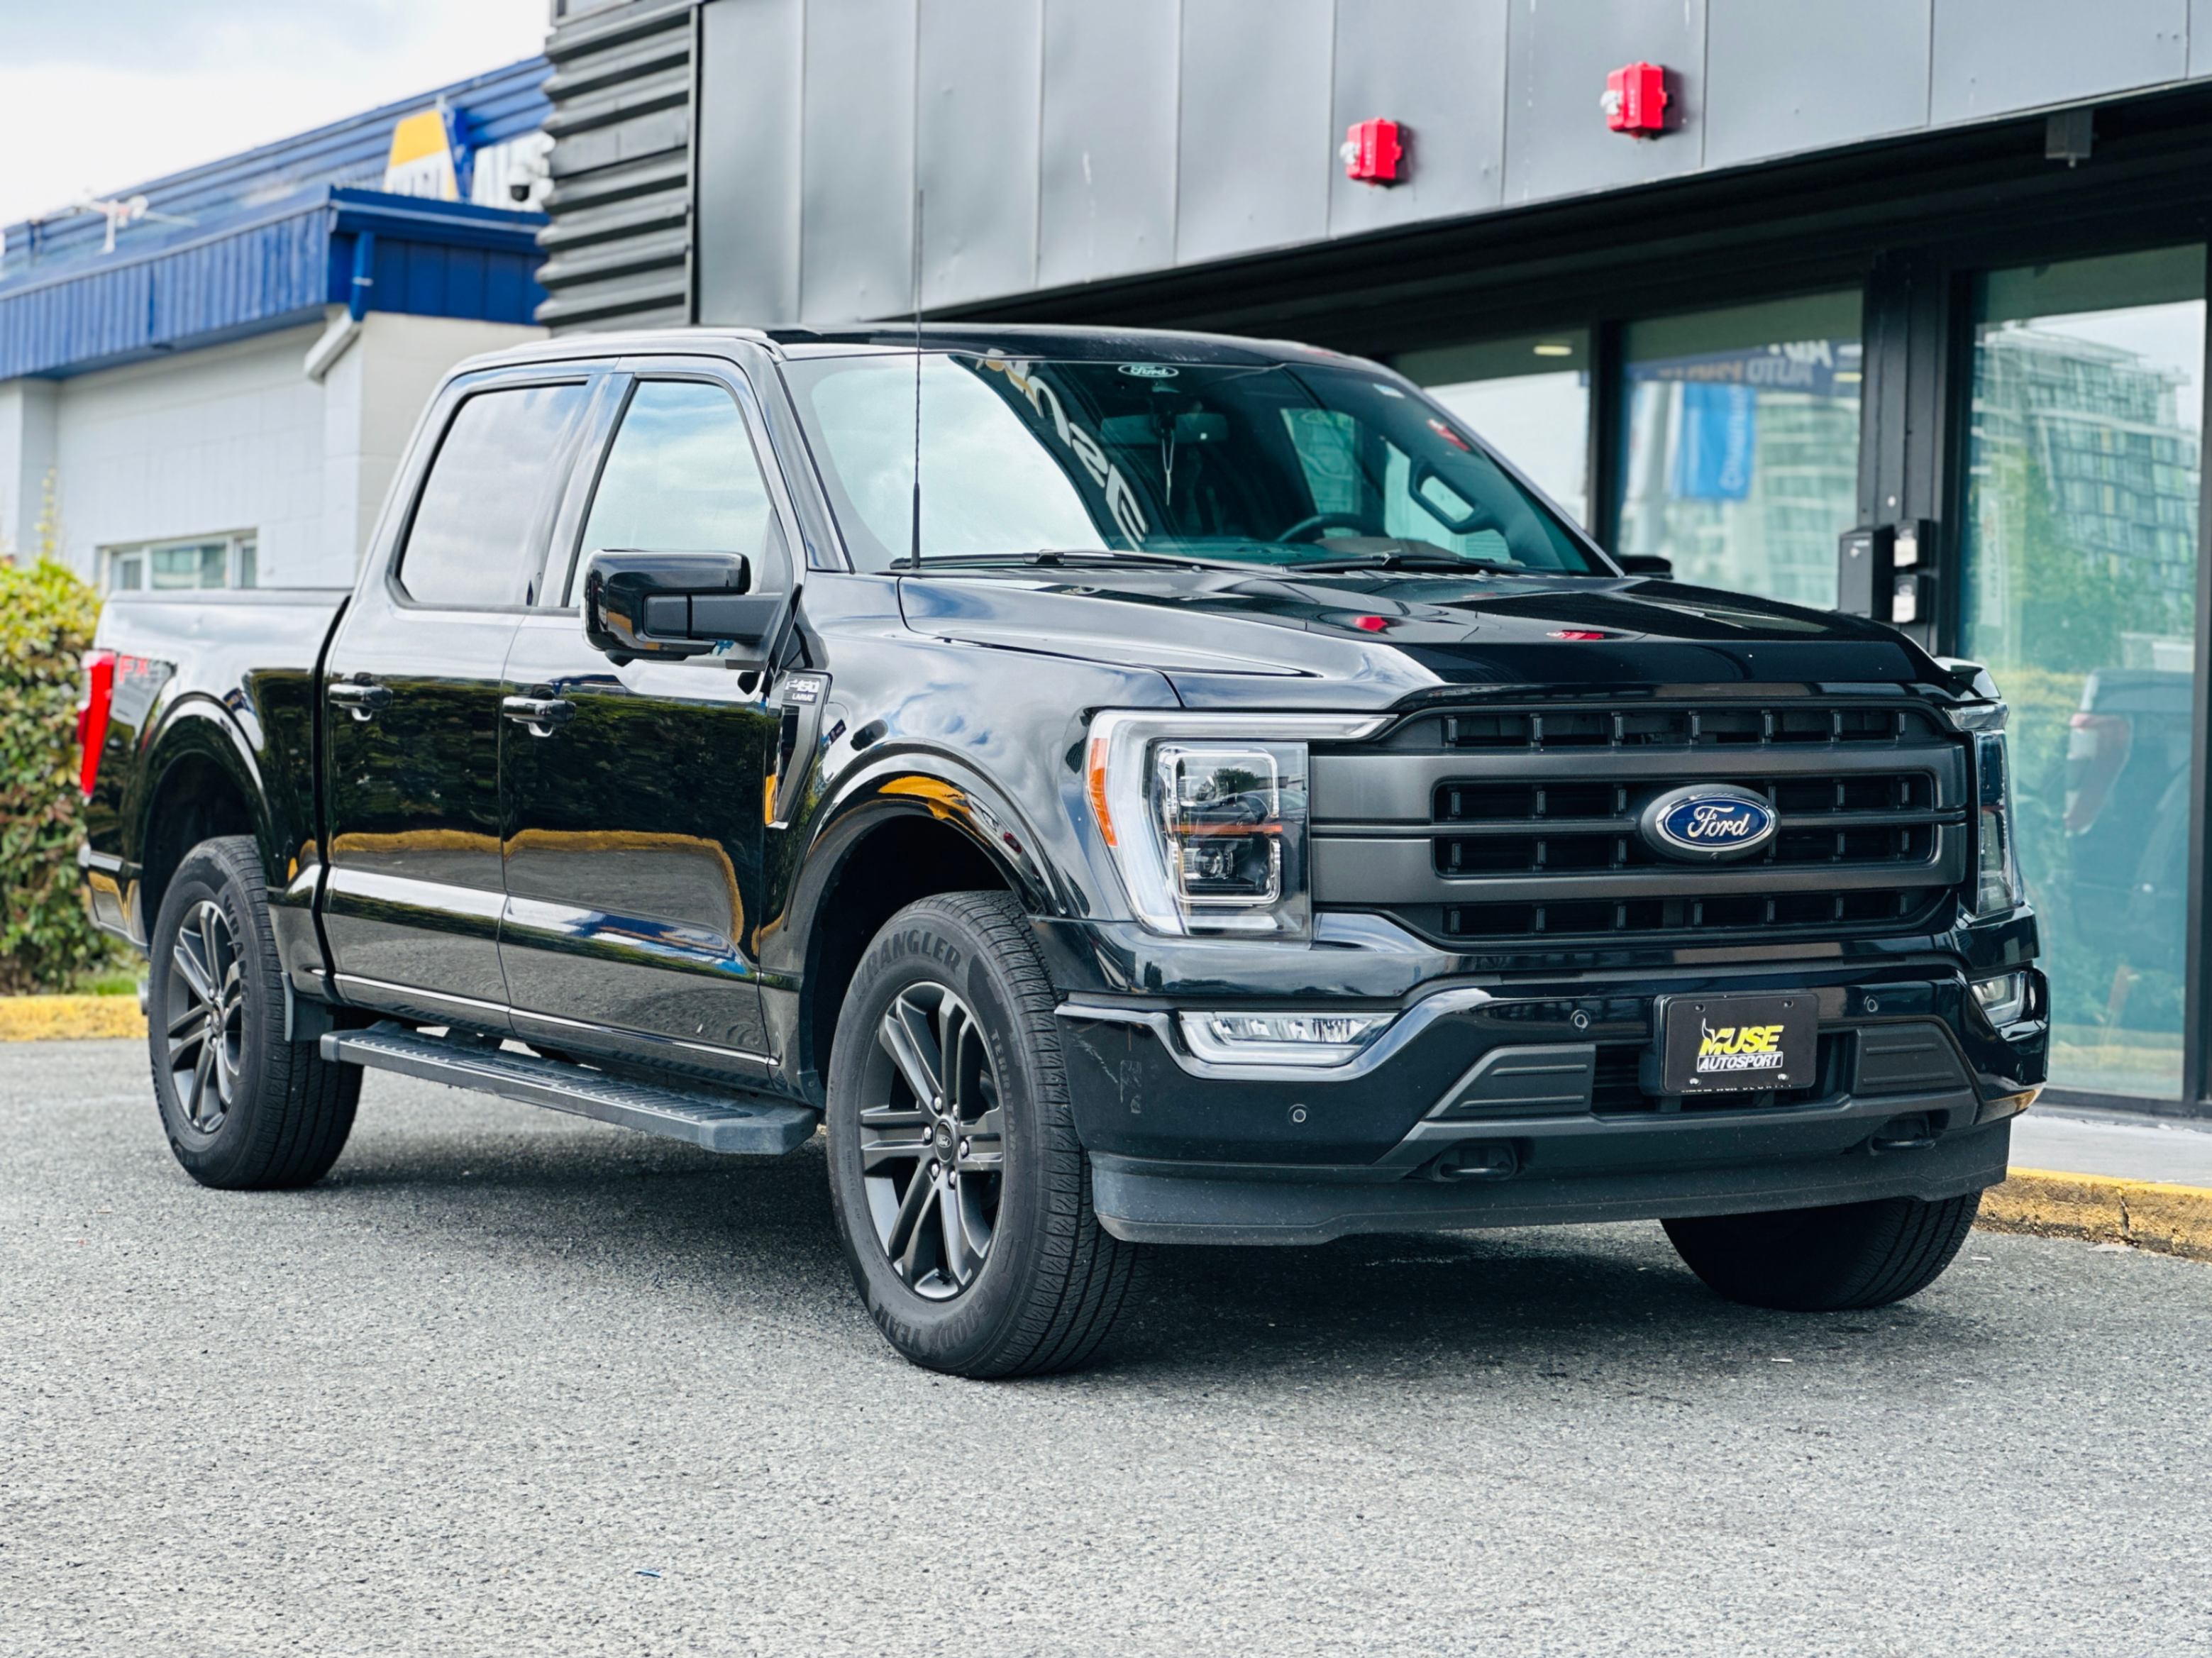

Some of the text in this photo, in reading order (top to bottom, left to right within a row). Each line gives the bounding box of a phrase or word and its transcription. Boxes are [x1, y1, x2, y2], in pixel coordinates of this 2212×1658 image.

[1687, 806, 1750, 838] Ford
[852, 929, 961, 1000] WRANGLER
[1698, 1022, 1784, 1056] MUSE
[1699, 1054, 1781, 1071] AUTOSPORT
